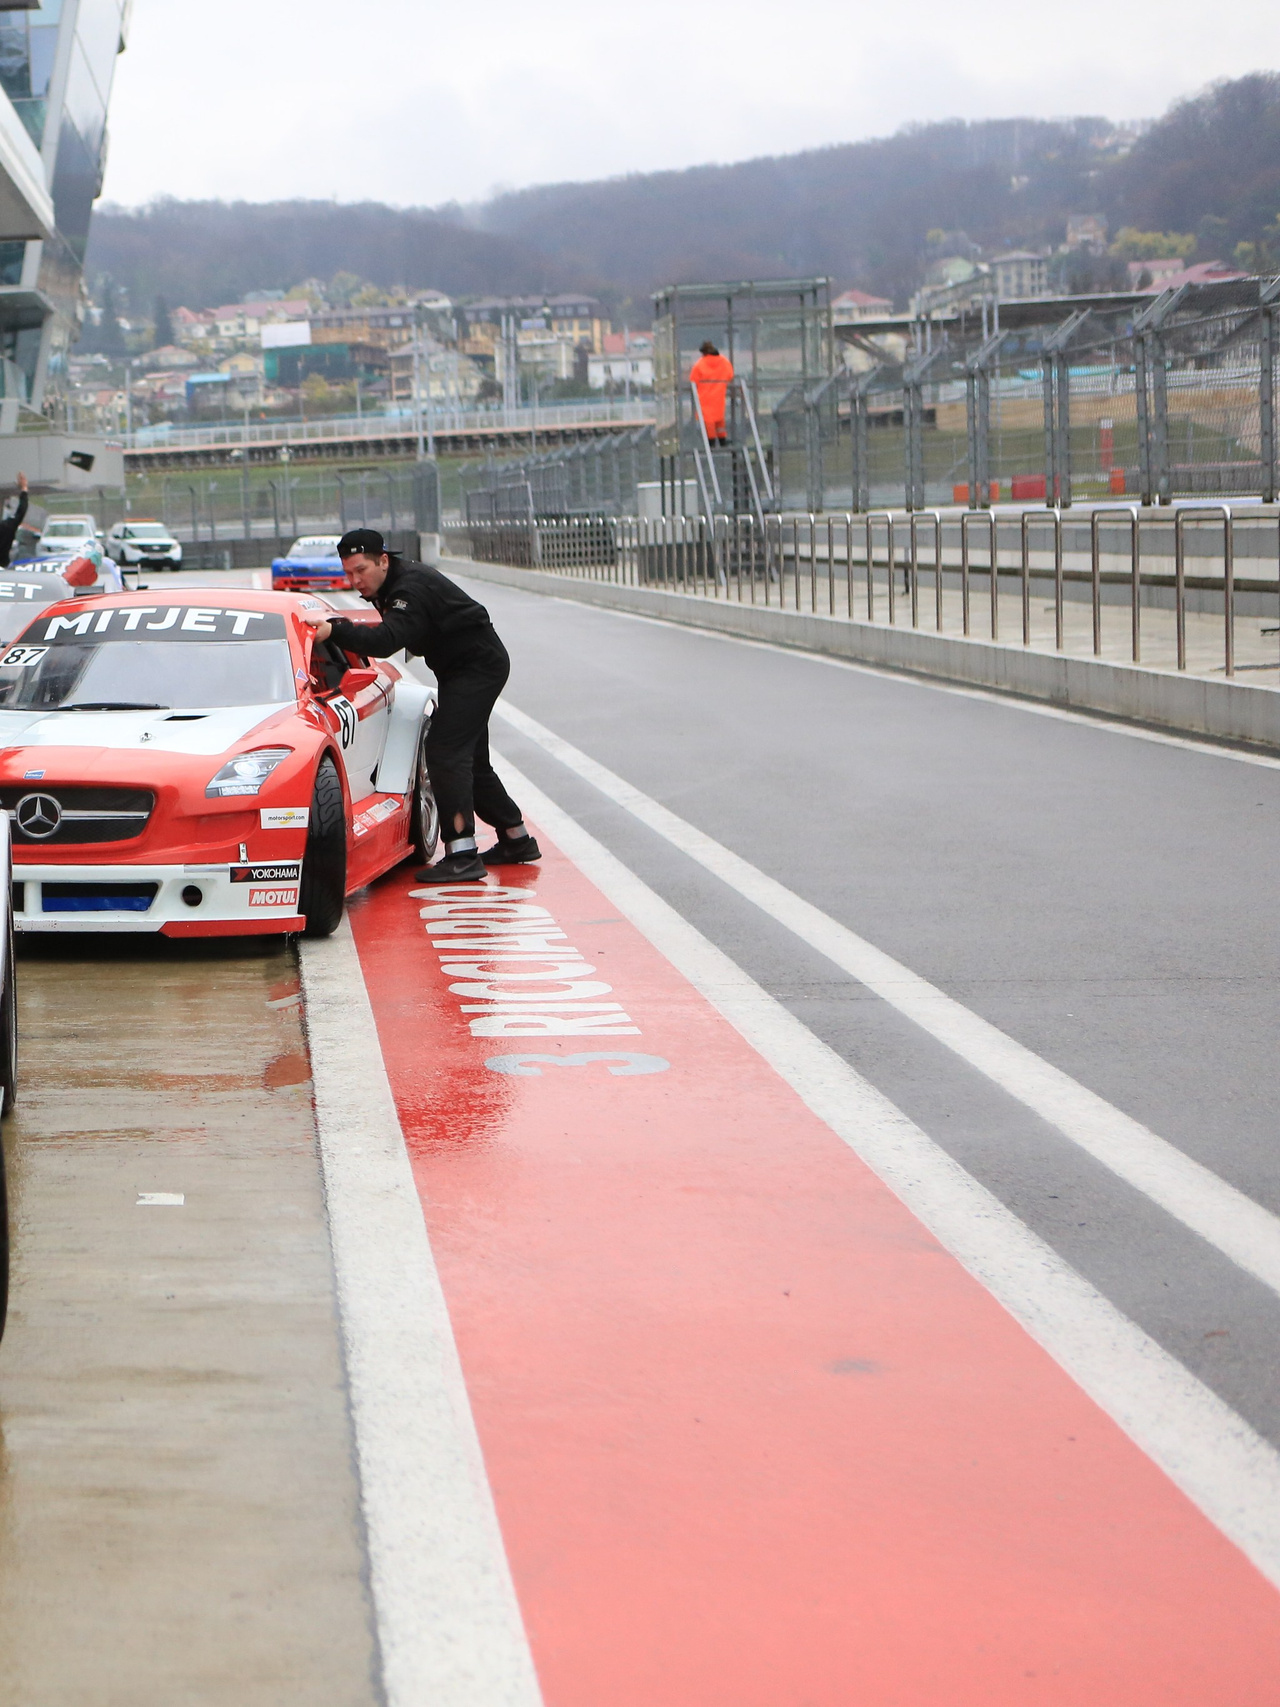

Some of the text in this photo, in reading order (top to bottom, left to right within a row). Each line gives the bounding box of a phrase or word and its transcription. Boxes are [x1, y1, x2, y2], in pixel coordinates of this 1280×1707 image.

[43, 606, 265, 641] MITJET
[3, 648, 46, 665] 87
[334, 699, 356, 750] 87
[267, 814, 306, 822] motorsport.com
[251, 868, 298, 880] YOKOHAMA
[251, 890, 296, 905] MOTUL
[408, 885, 671, 1076] 3 RICCIARDO
